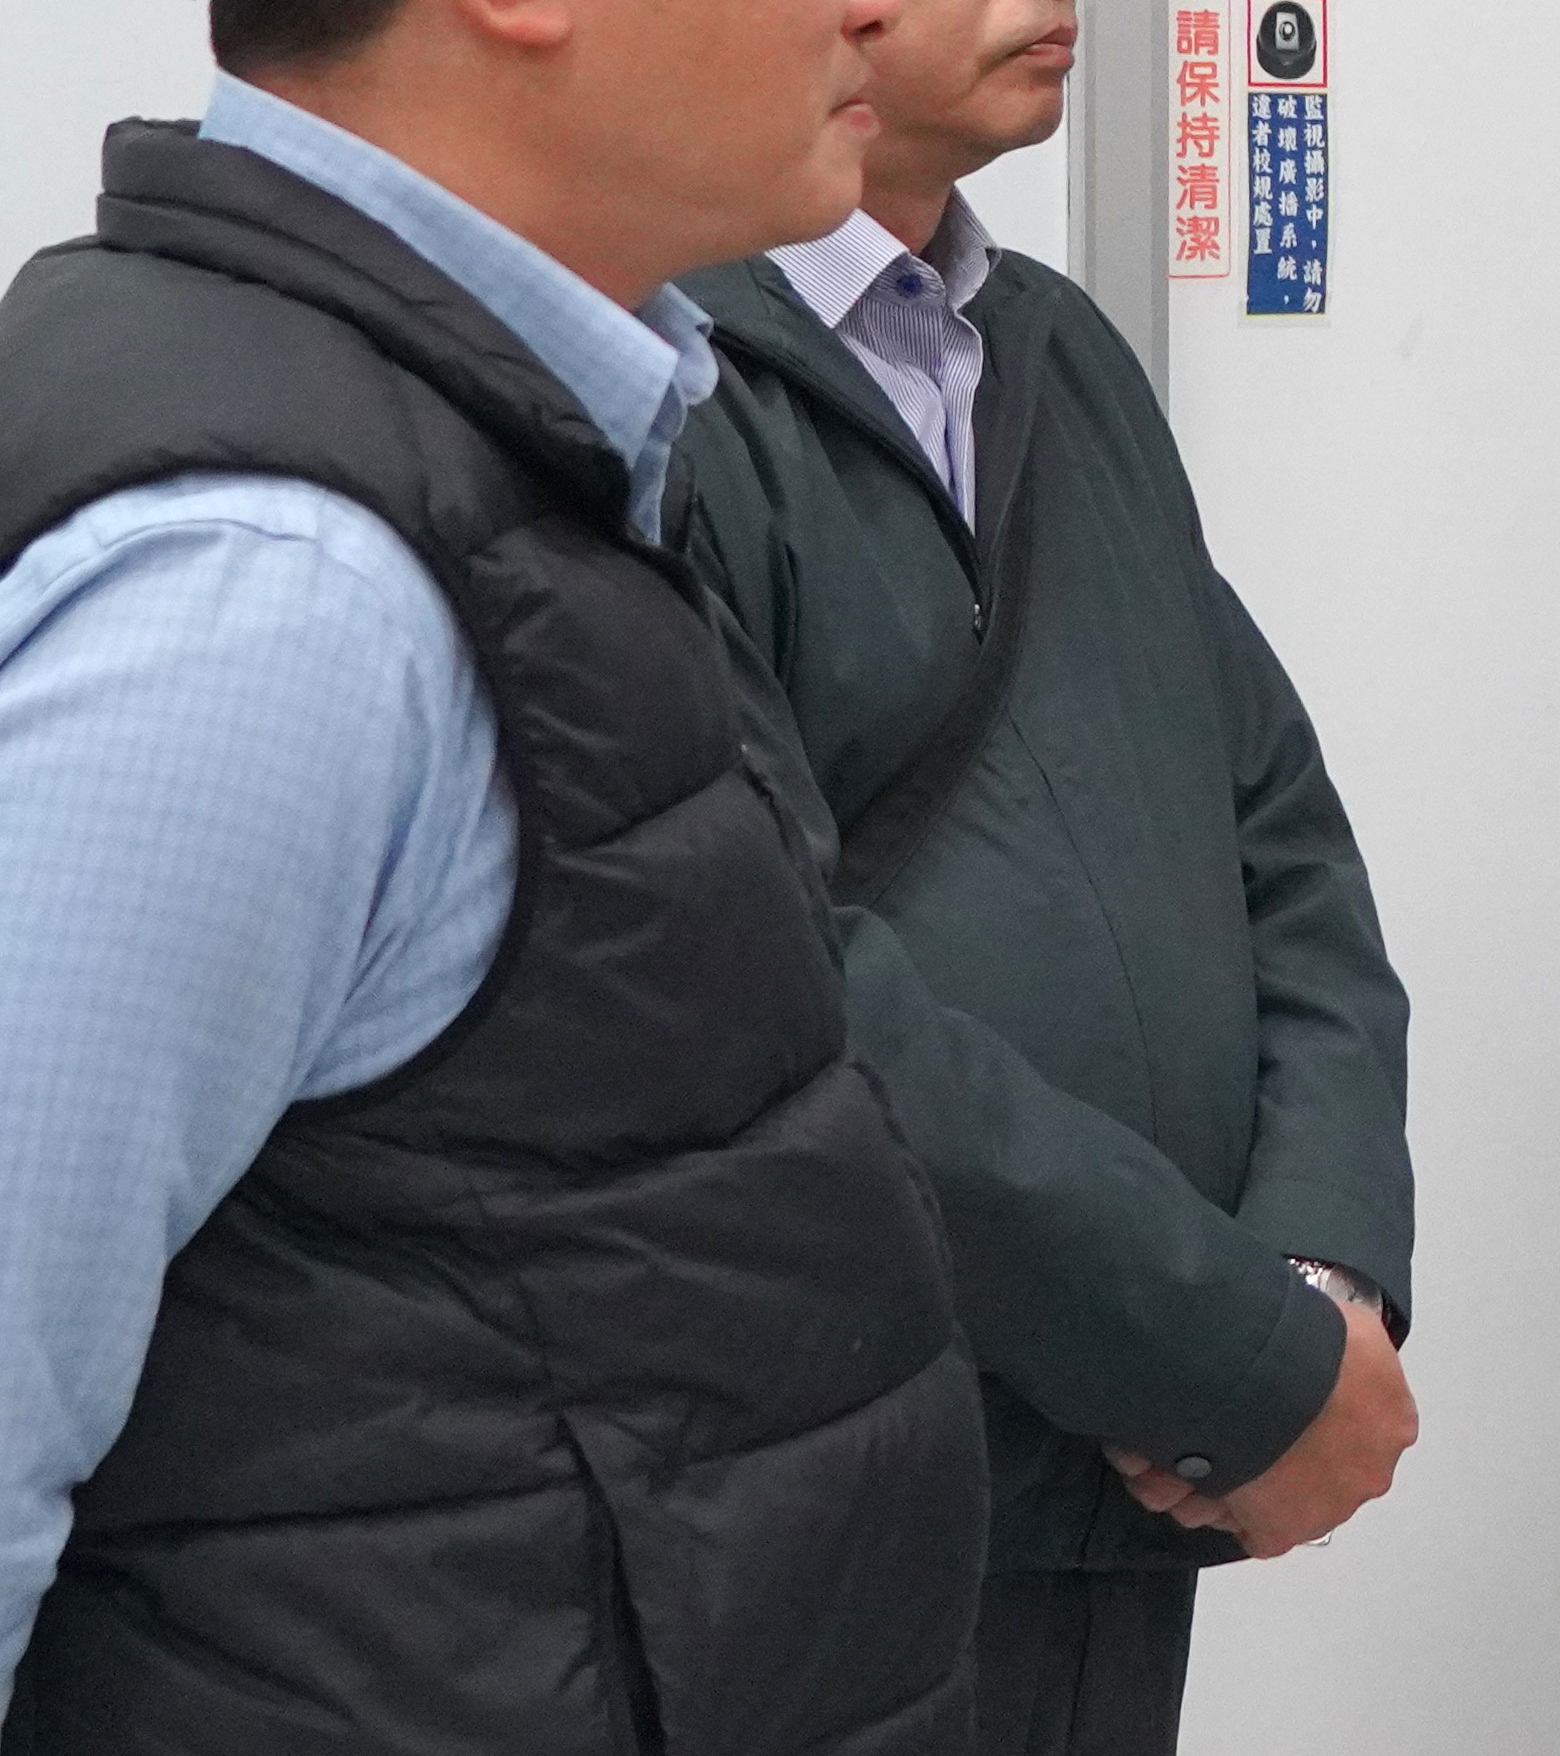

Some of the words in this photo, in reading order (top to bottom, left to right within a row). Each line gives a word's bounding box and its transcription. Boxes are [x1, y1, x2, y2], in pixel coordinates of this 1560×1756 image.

[1175, 8, 1221, 262] 請保持清潔
[1251, 93, 1273, 255] 違者校規處置
